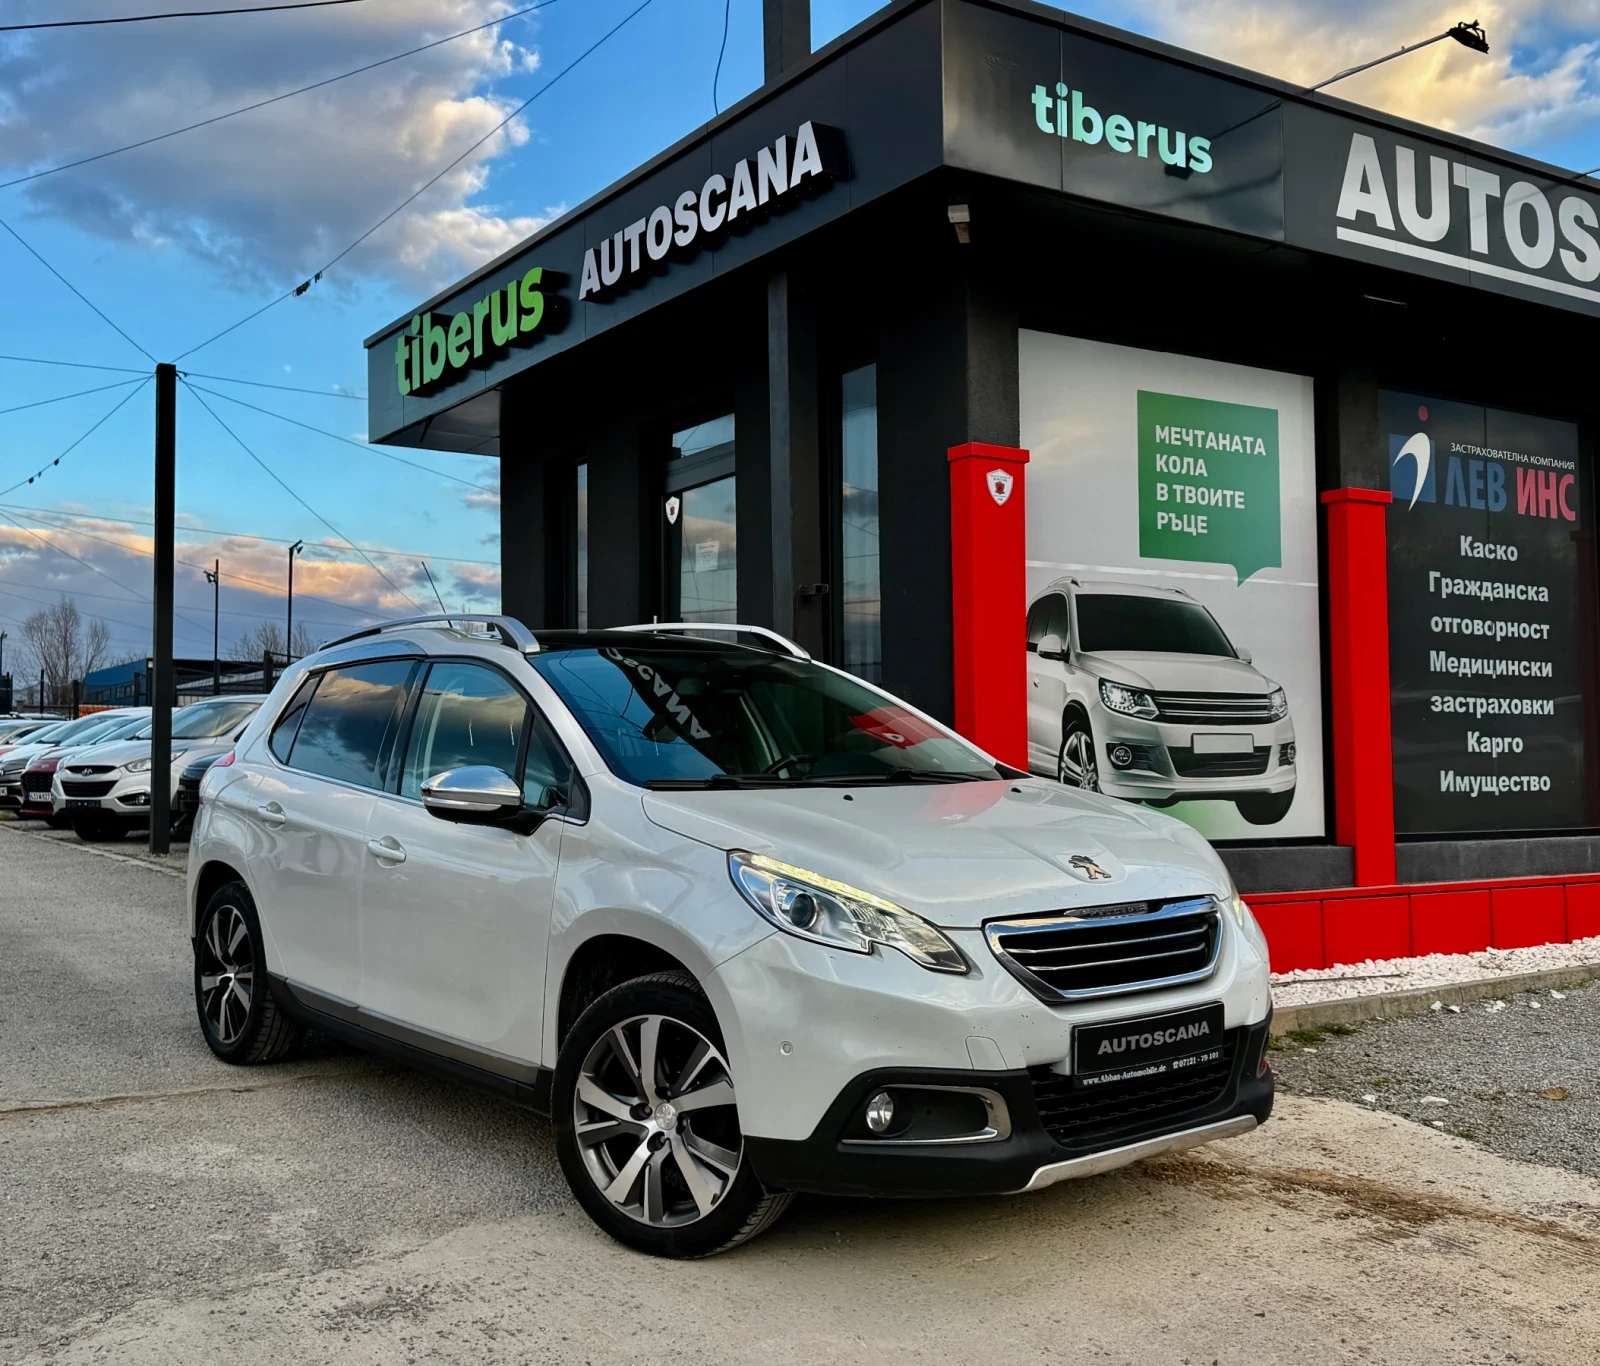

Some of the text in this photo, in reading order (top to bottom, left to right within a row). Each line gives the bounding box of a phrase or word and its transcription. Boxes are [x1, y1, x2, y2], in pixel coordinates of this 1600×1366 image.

[1031, 82, 1213, 174] tiberus
[578, 120, 824, 301] AUTOSCANA
[1336, 132, 1600, 283] AUTOS
[395, 266, 544, 396] tiberus
[1155, 424, 1267, 456] МЕЧТАНАТА
[1156, 453, 1208, 477] КОЛА
[1450, 442, 1575, 470] ЗАСТРАХОВАТЕЛНА КОМПАНИЯ
[1156, 482, 1245, 509] В ТВОИТЕ
[1444, 455, 1576, 521] ЛЕВ ИНС
[1157, 511, 1208, 536] РЪЦЕ
[1460, 535, 1518, 561] Каско
[1429, 570, 1549, 602] Гражданска
[1430, 616, 1550, 641] отговорност
[1429, 650, 1553, 679] Медицински
[1430, 696, 1554, 718] застраховки
[1467, 731, 1523, 757] Карго
[1440, 770, 1551, 797] Имущество
[1097, 1021, 1210, 1055] AUTOSCANA
